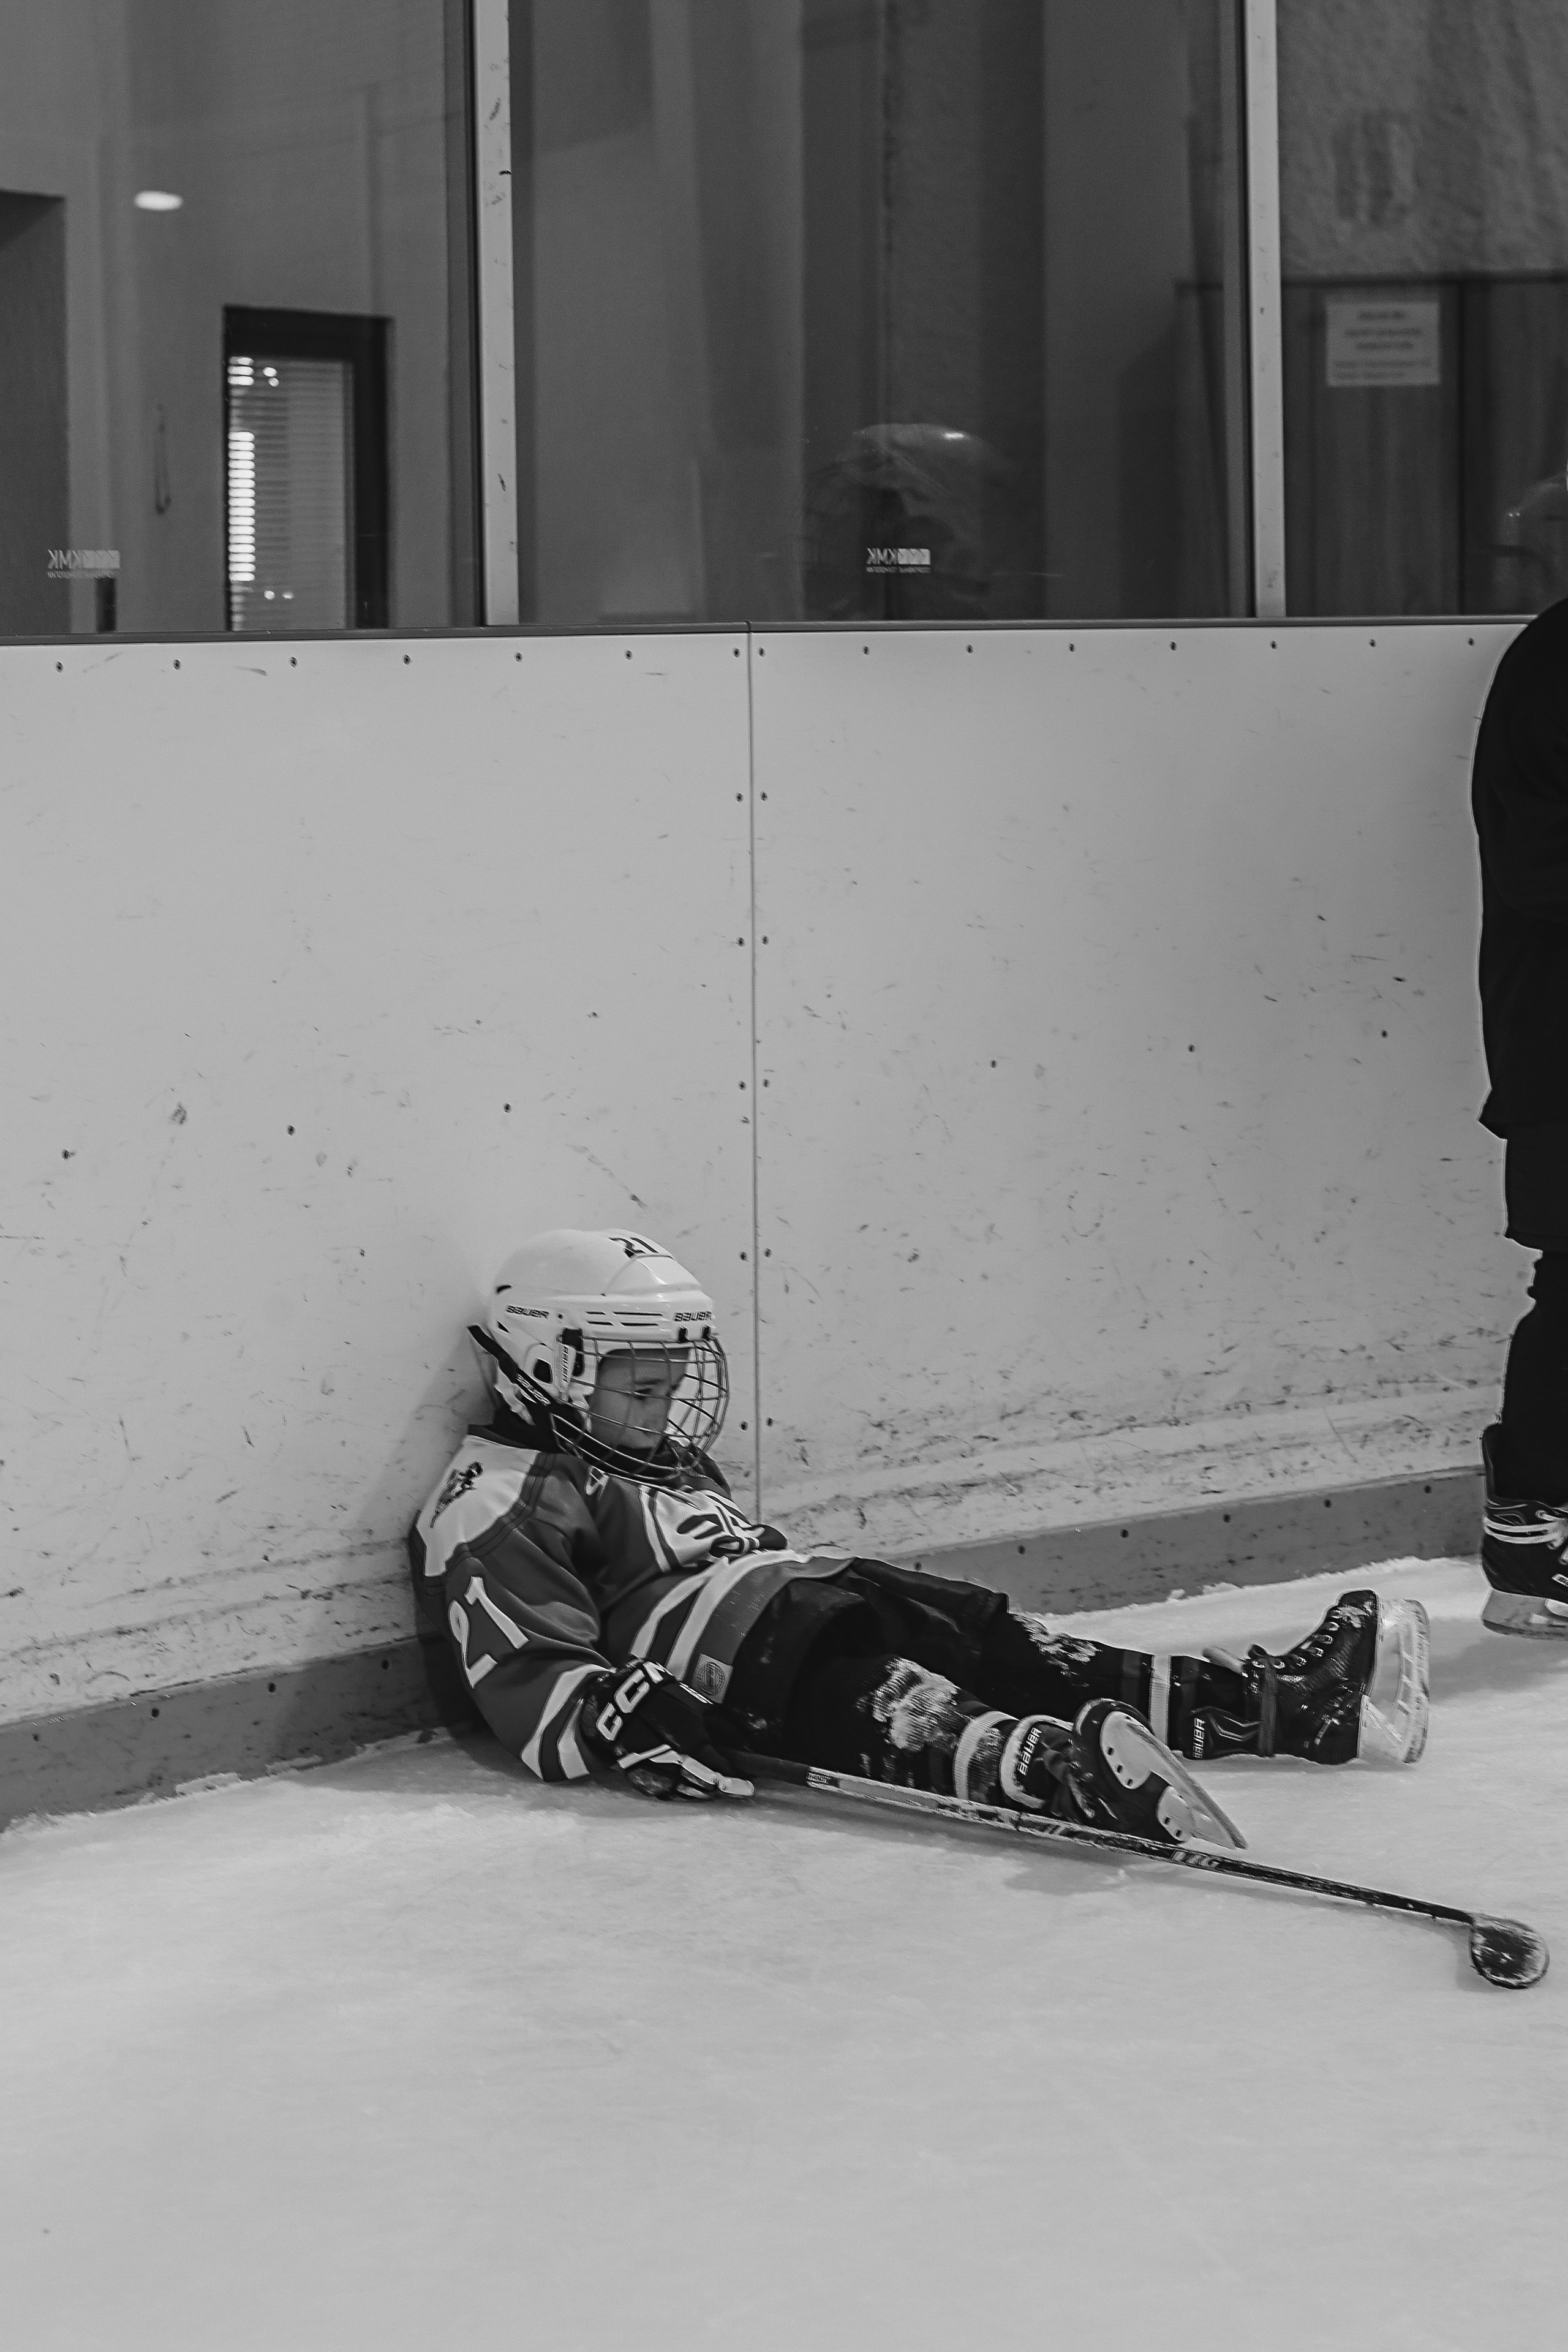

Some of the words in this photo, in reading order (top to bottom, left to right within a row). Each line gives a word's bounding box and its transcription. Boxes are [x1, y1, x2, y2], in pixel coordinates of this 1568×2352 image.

[506, 1305, 549, 1319] BAUER
[674, 1311, 712, 1322] BAUER
[1017, 1727, 1042, 1776] BAUER
[1193, 1717, 1205, 1759] BAUER
